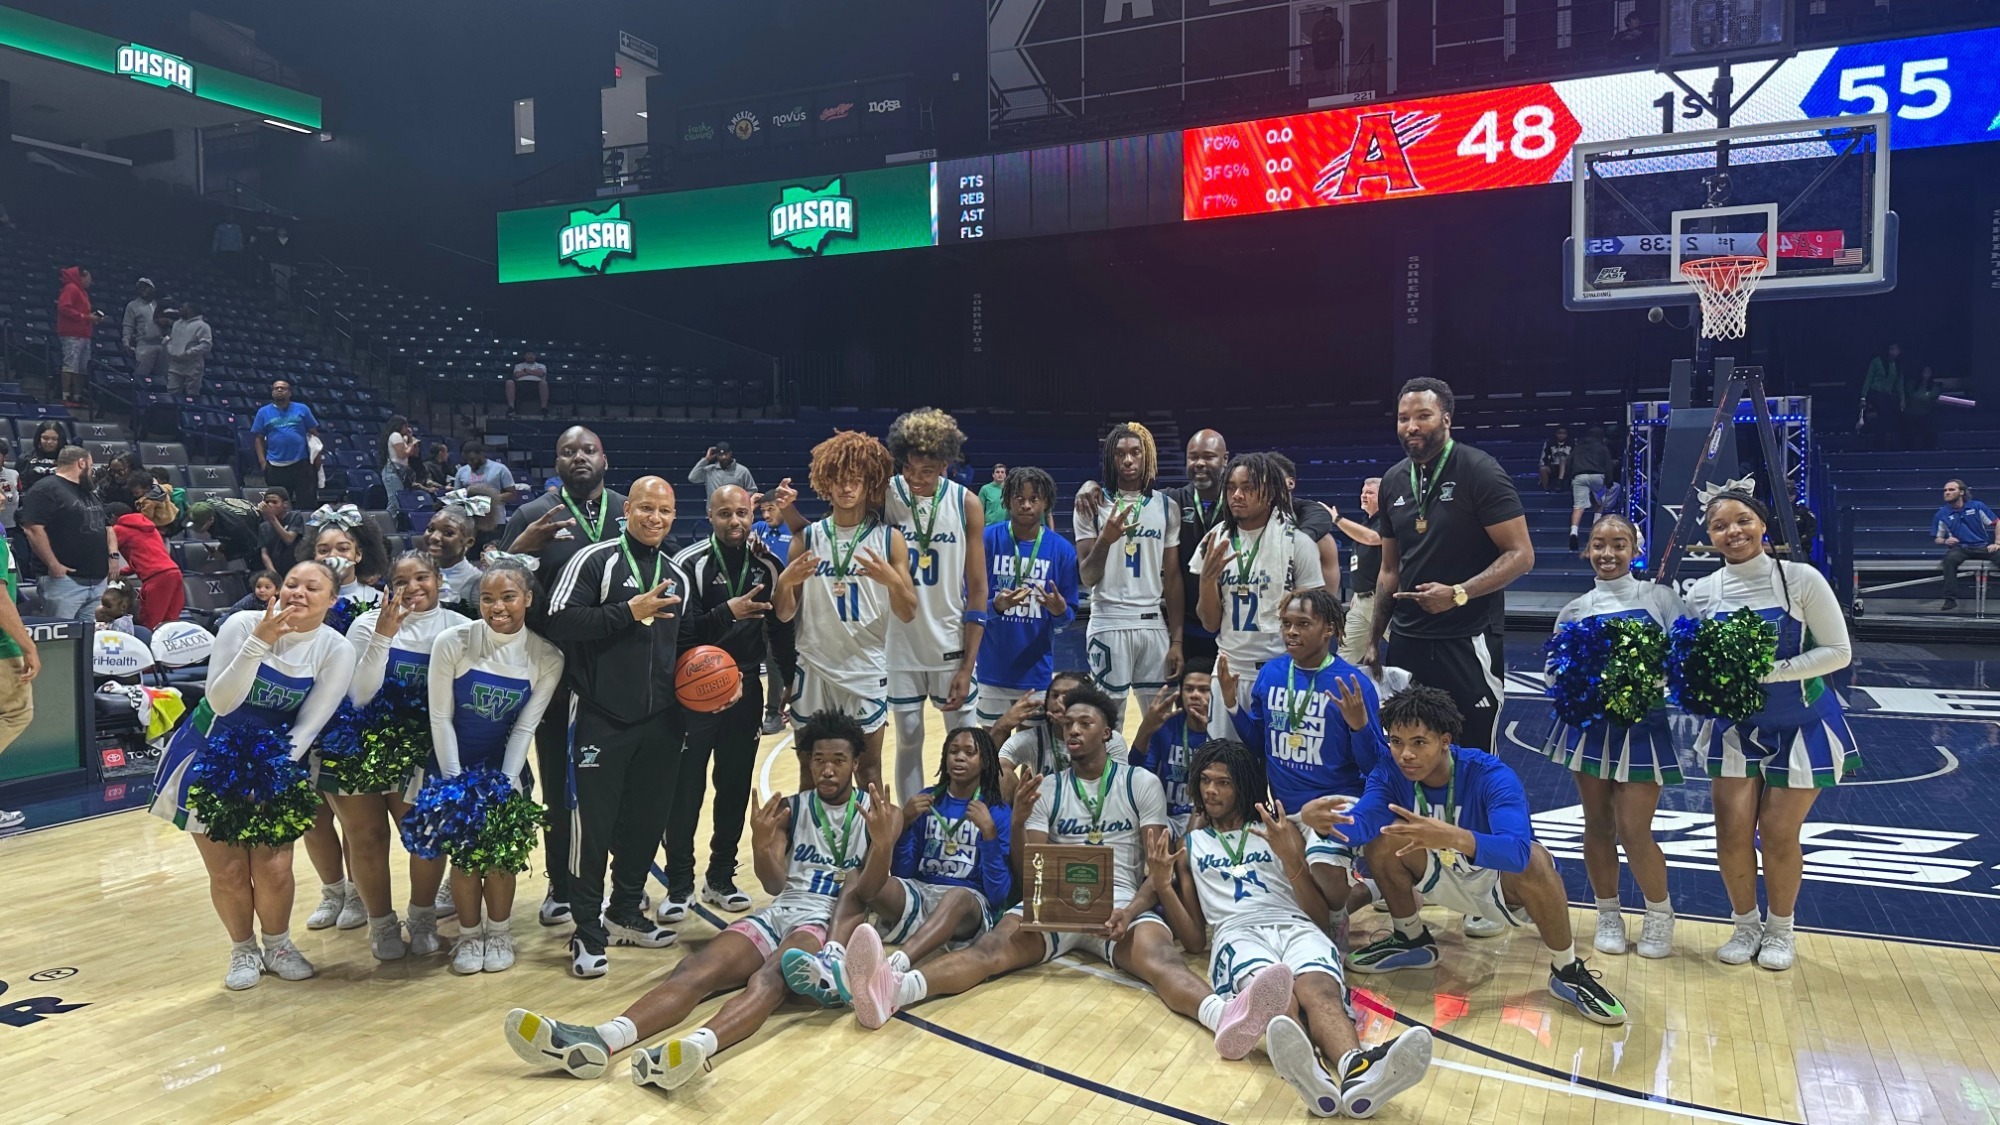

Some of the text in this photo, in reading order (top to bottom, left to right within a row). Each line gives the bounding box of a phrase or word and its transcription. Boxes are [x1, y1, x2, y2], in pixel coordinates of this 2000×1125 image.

[119, 48, 192, 90] OHSAA
[1353, 92, 1373, 102] 221
[1839, 57, 1952, 121] 55
[869, 99, 902, 112] noosa
[731, 110, 761, 132] MEXICANA
[773, 111, 807, 127] novus
[1203, 127, 1293, 153] FG% 0.0
[1456, 104, 1557, 164] 48
[1203, 157, 1293, 182] 3FG% 0.0
[960, 175, 984, 189] PTS
[960, 192, 985, 206] REB
[1203, 187, 1292, 211] FT% 0.0
[772, 199, 851, 237] OHSAA
[960, 208, 985, 222] AST
[561, 222, 631, 256] OHSAA
[960, 225, 984, 239] FLS
[908, 547, 939, 586] 20
[1126, 543, 1141, 578] 4
[833, 582, 860, 622] 11
[1230, 591, 1260, 631] 12
[162, 633, 209, 652] BEACON
[685, 654, 723, 677] Rawlings
[696, 674, 730, 697] OHSAA
[1270, 730, 1324, 766] LOCK
